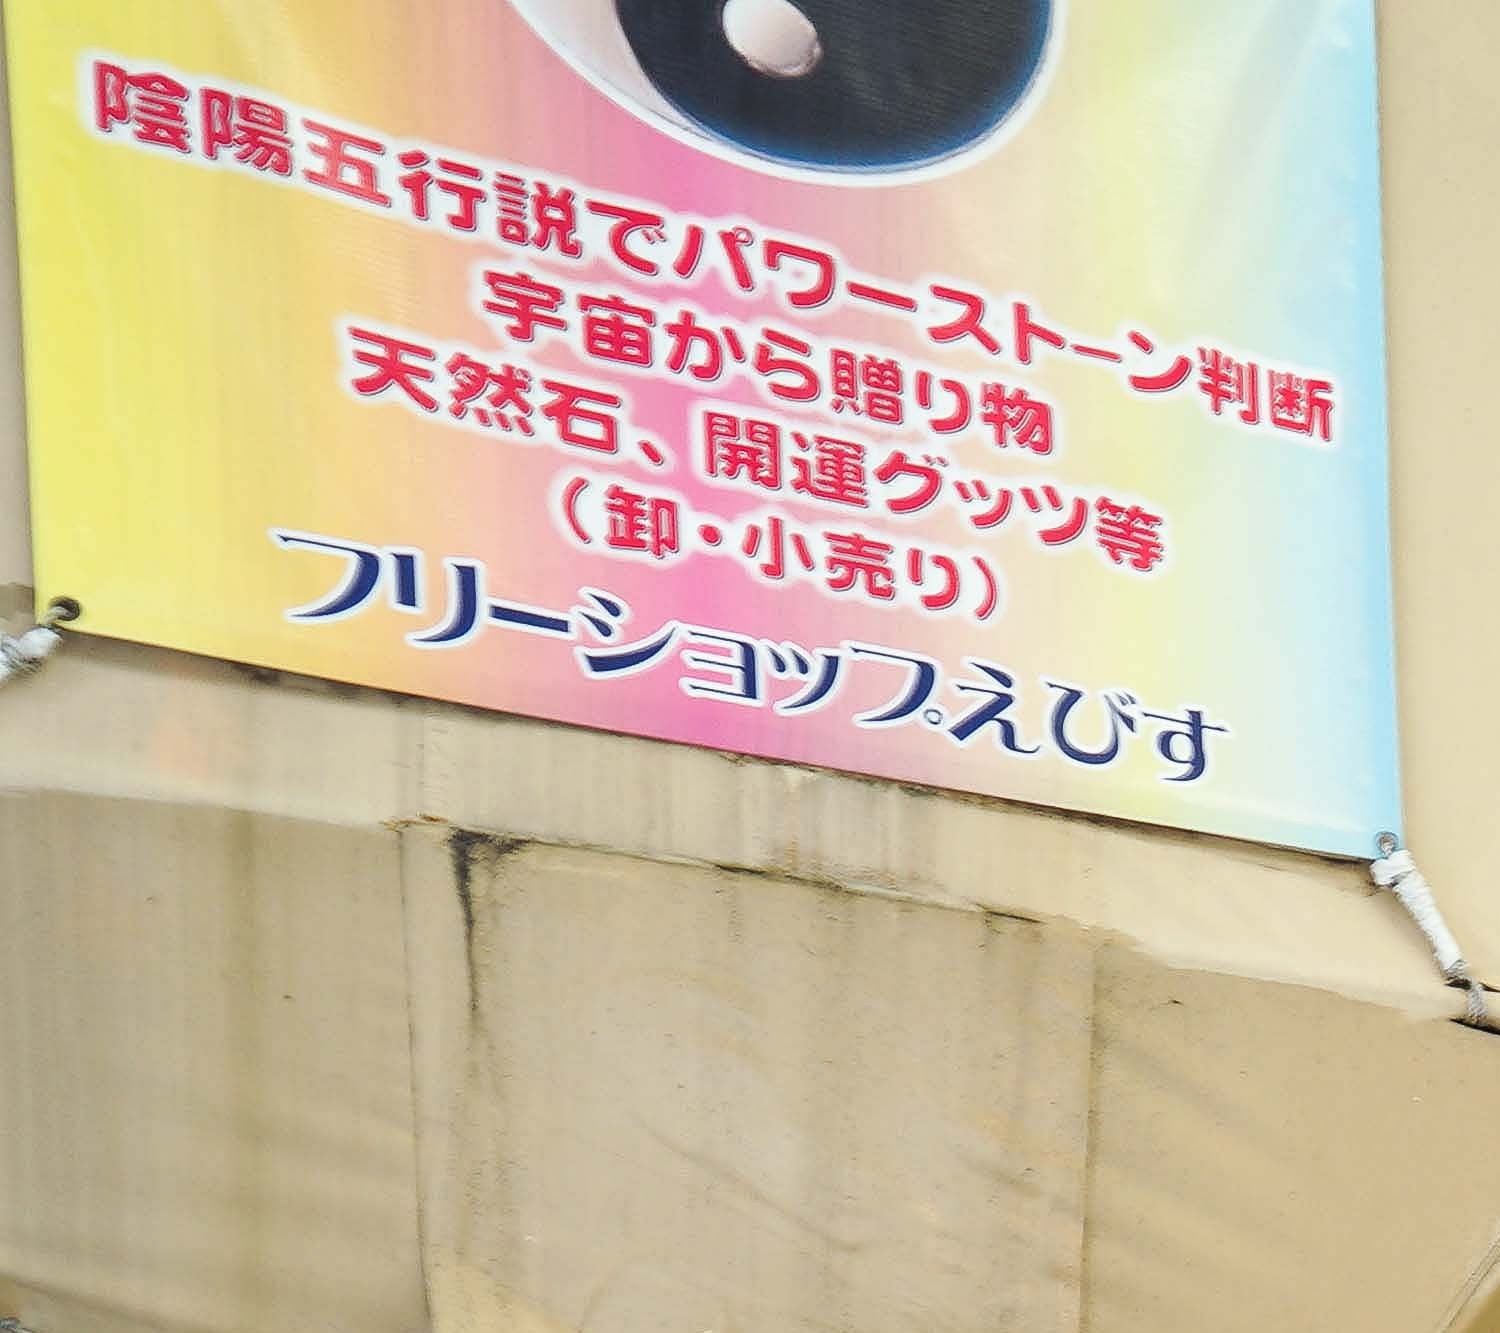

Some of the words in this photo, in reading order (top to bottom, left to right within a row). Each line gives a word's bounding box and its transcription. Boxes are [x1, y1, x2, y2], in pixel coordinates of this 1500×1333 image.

[92, 61, 1336, 441] 陰陽五行説でパワーストーン判断
[481, 269, 1055, 456] 宇宙から贈り物
[273, 532, 1229, 783] フリーショップえびす
